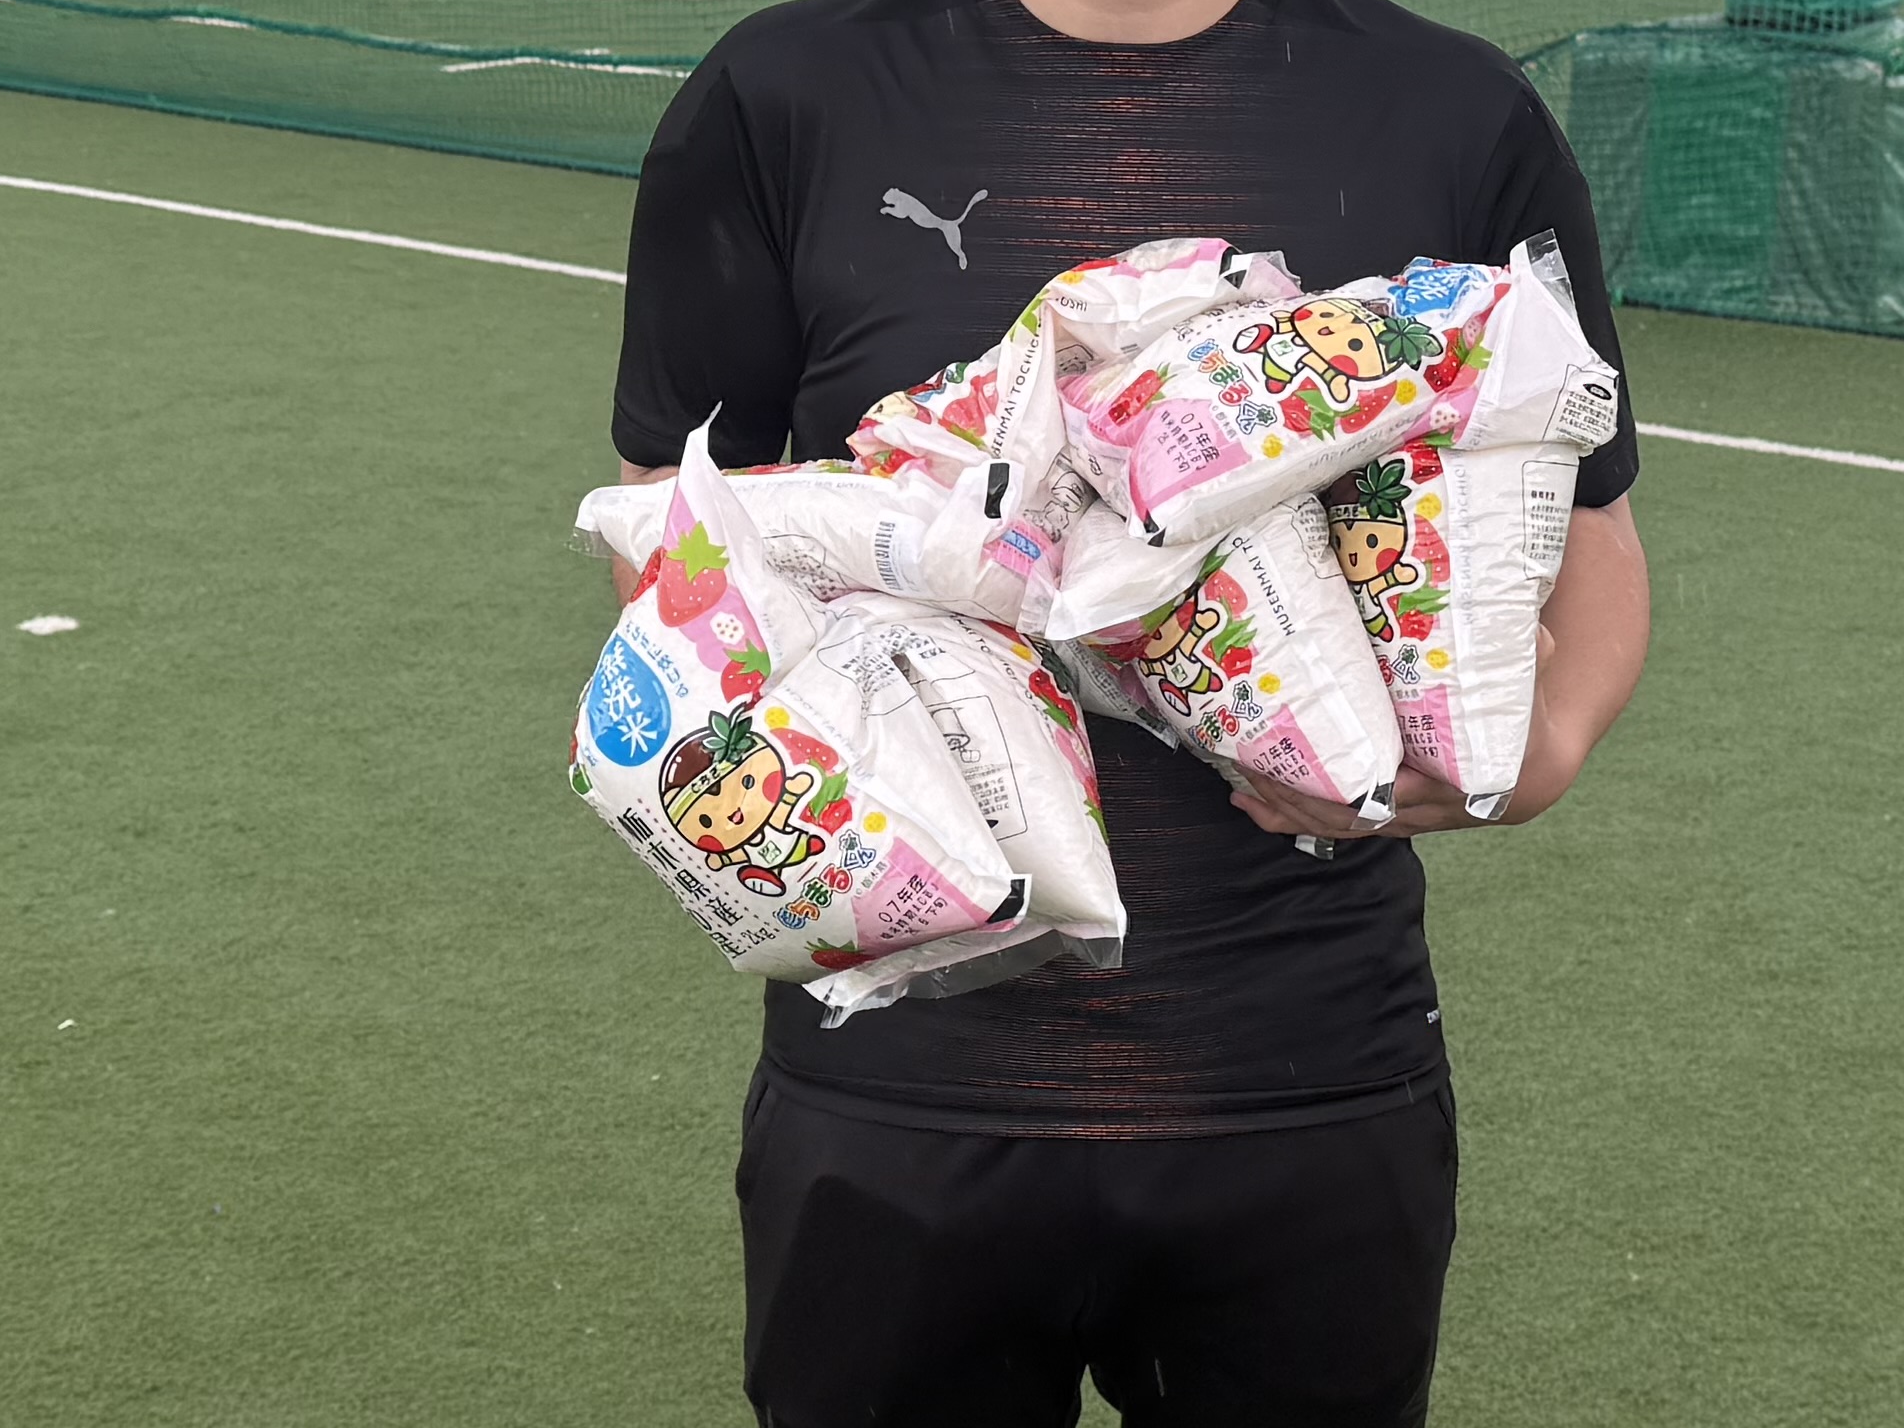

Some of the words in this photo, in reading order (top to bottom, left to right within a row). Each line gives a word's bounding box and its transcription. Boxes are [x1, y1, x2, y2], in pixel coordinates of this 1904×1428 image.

[1056, 296, 1088, 313] OSHI
[1248, 556, 1296, 637] MUSENMAI
[601, 639, 658, 759] 無洗米
[1398, 714, 1436, 731] 7年産
[1253, 736, 1296, 771] 07年産
[878, 874, 926, 923] 07年産
